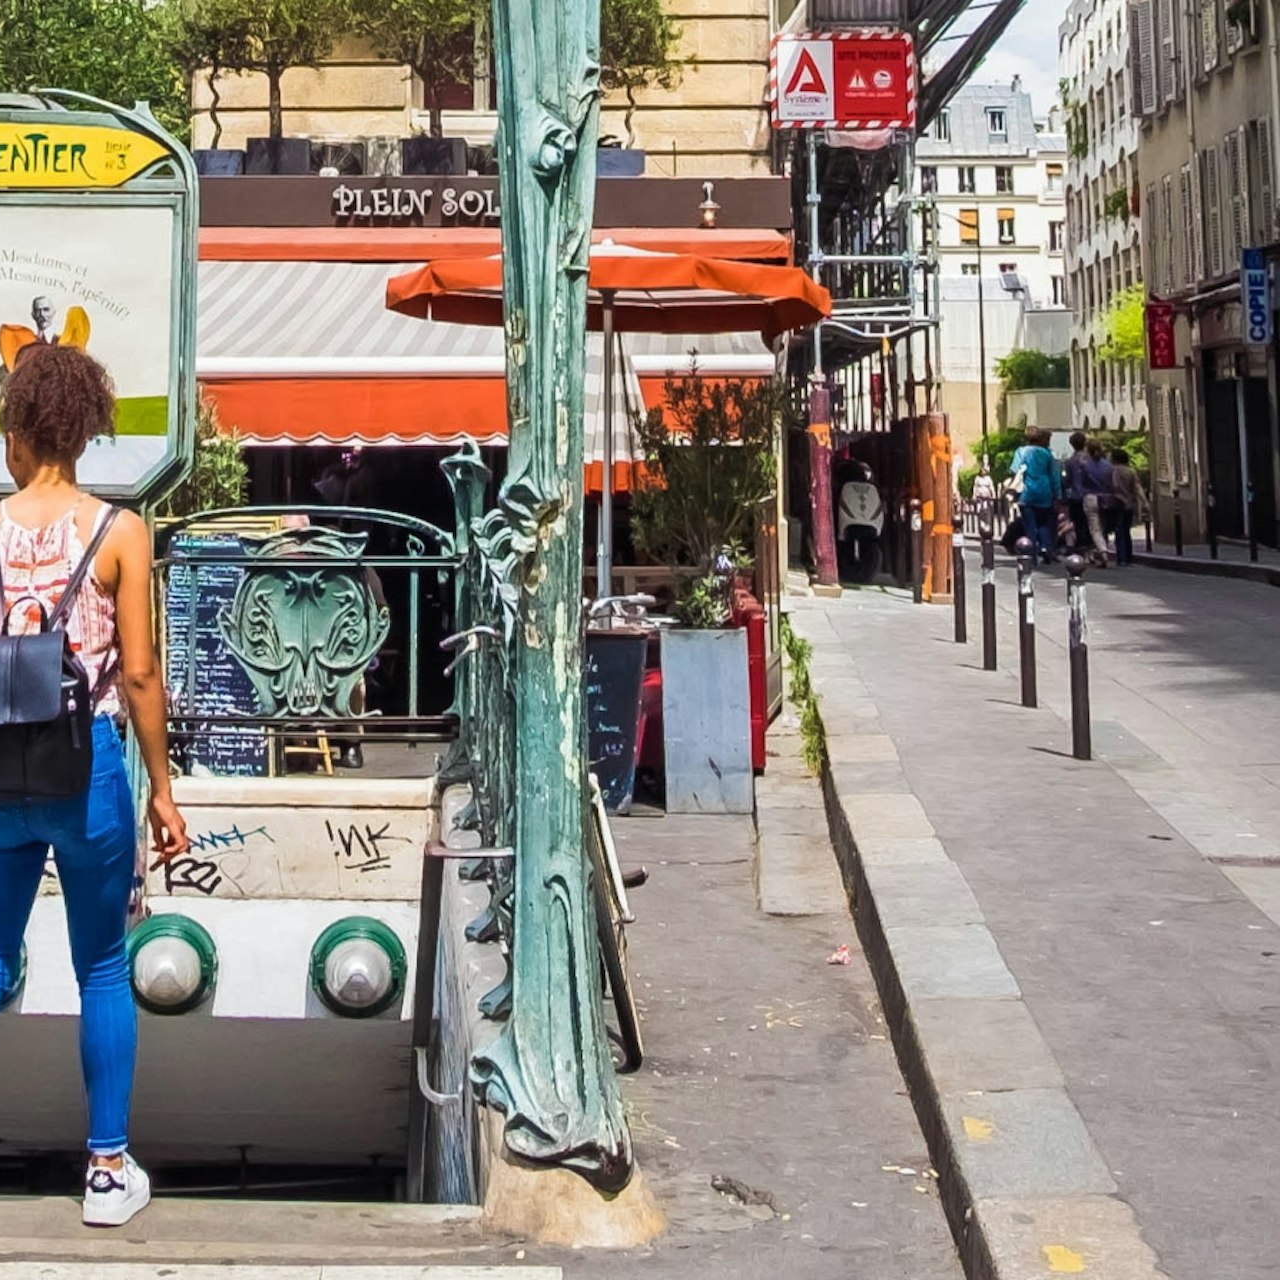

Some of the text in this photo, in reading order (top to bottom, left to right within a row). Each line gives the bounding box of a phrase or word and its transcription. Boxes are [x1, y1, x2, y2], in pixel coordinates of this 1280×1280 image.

[117, 153, 127, 170] 3
[332, 185, 433, 216] PLEIN
[1, 249, 88, 277] Mesdames et
[1249, 273, 1267, 342] COPIE
